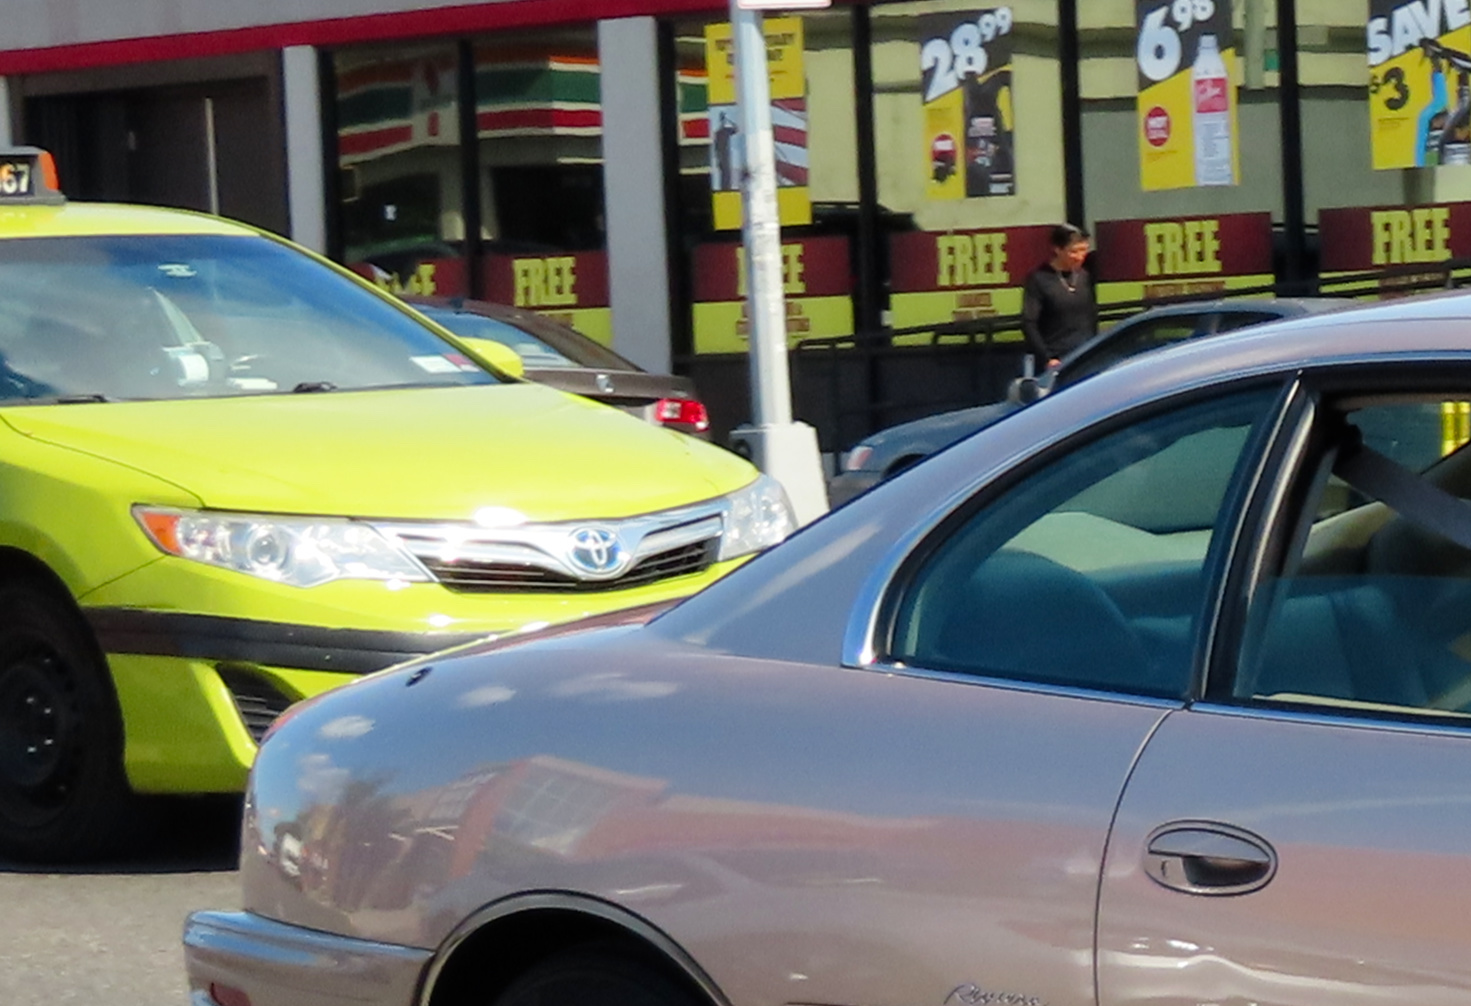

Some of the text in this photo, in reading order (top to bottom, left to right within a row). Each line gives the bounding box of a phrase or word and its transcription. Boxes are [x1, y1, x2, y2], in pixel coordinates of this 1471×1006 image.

[0, 163, 30, 194] 67
[936, 233, 1010, 286] FREE
[1145, 220, 1222, 275] FREE
[1371, 208, 1452, 265] FREE
[513, 256, 578, 307] FREE
